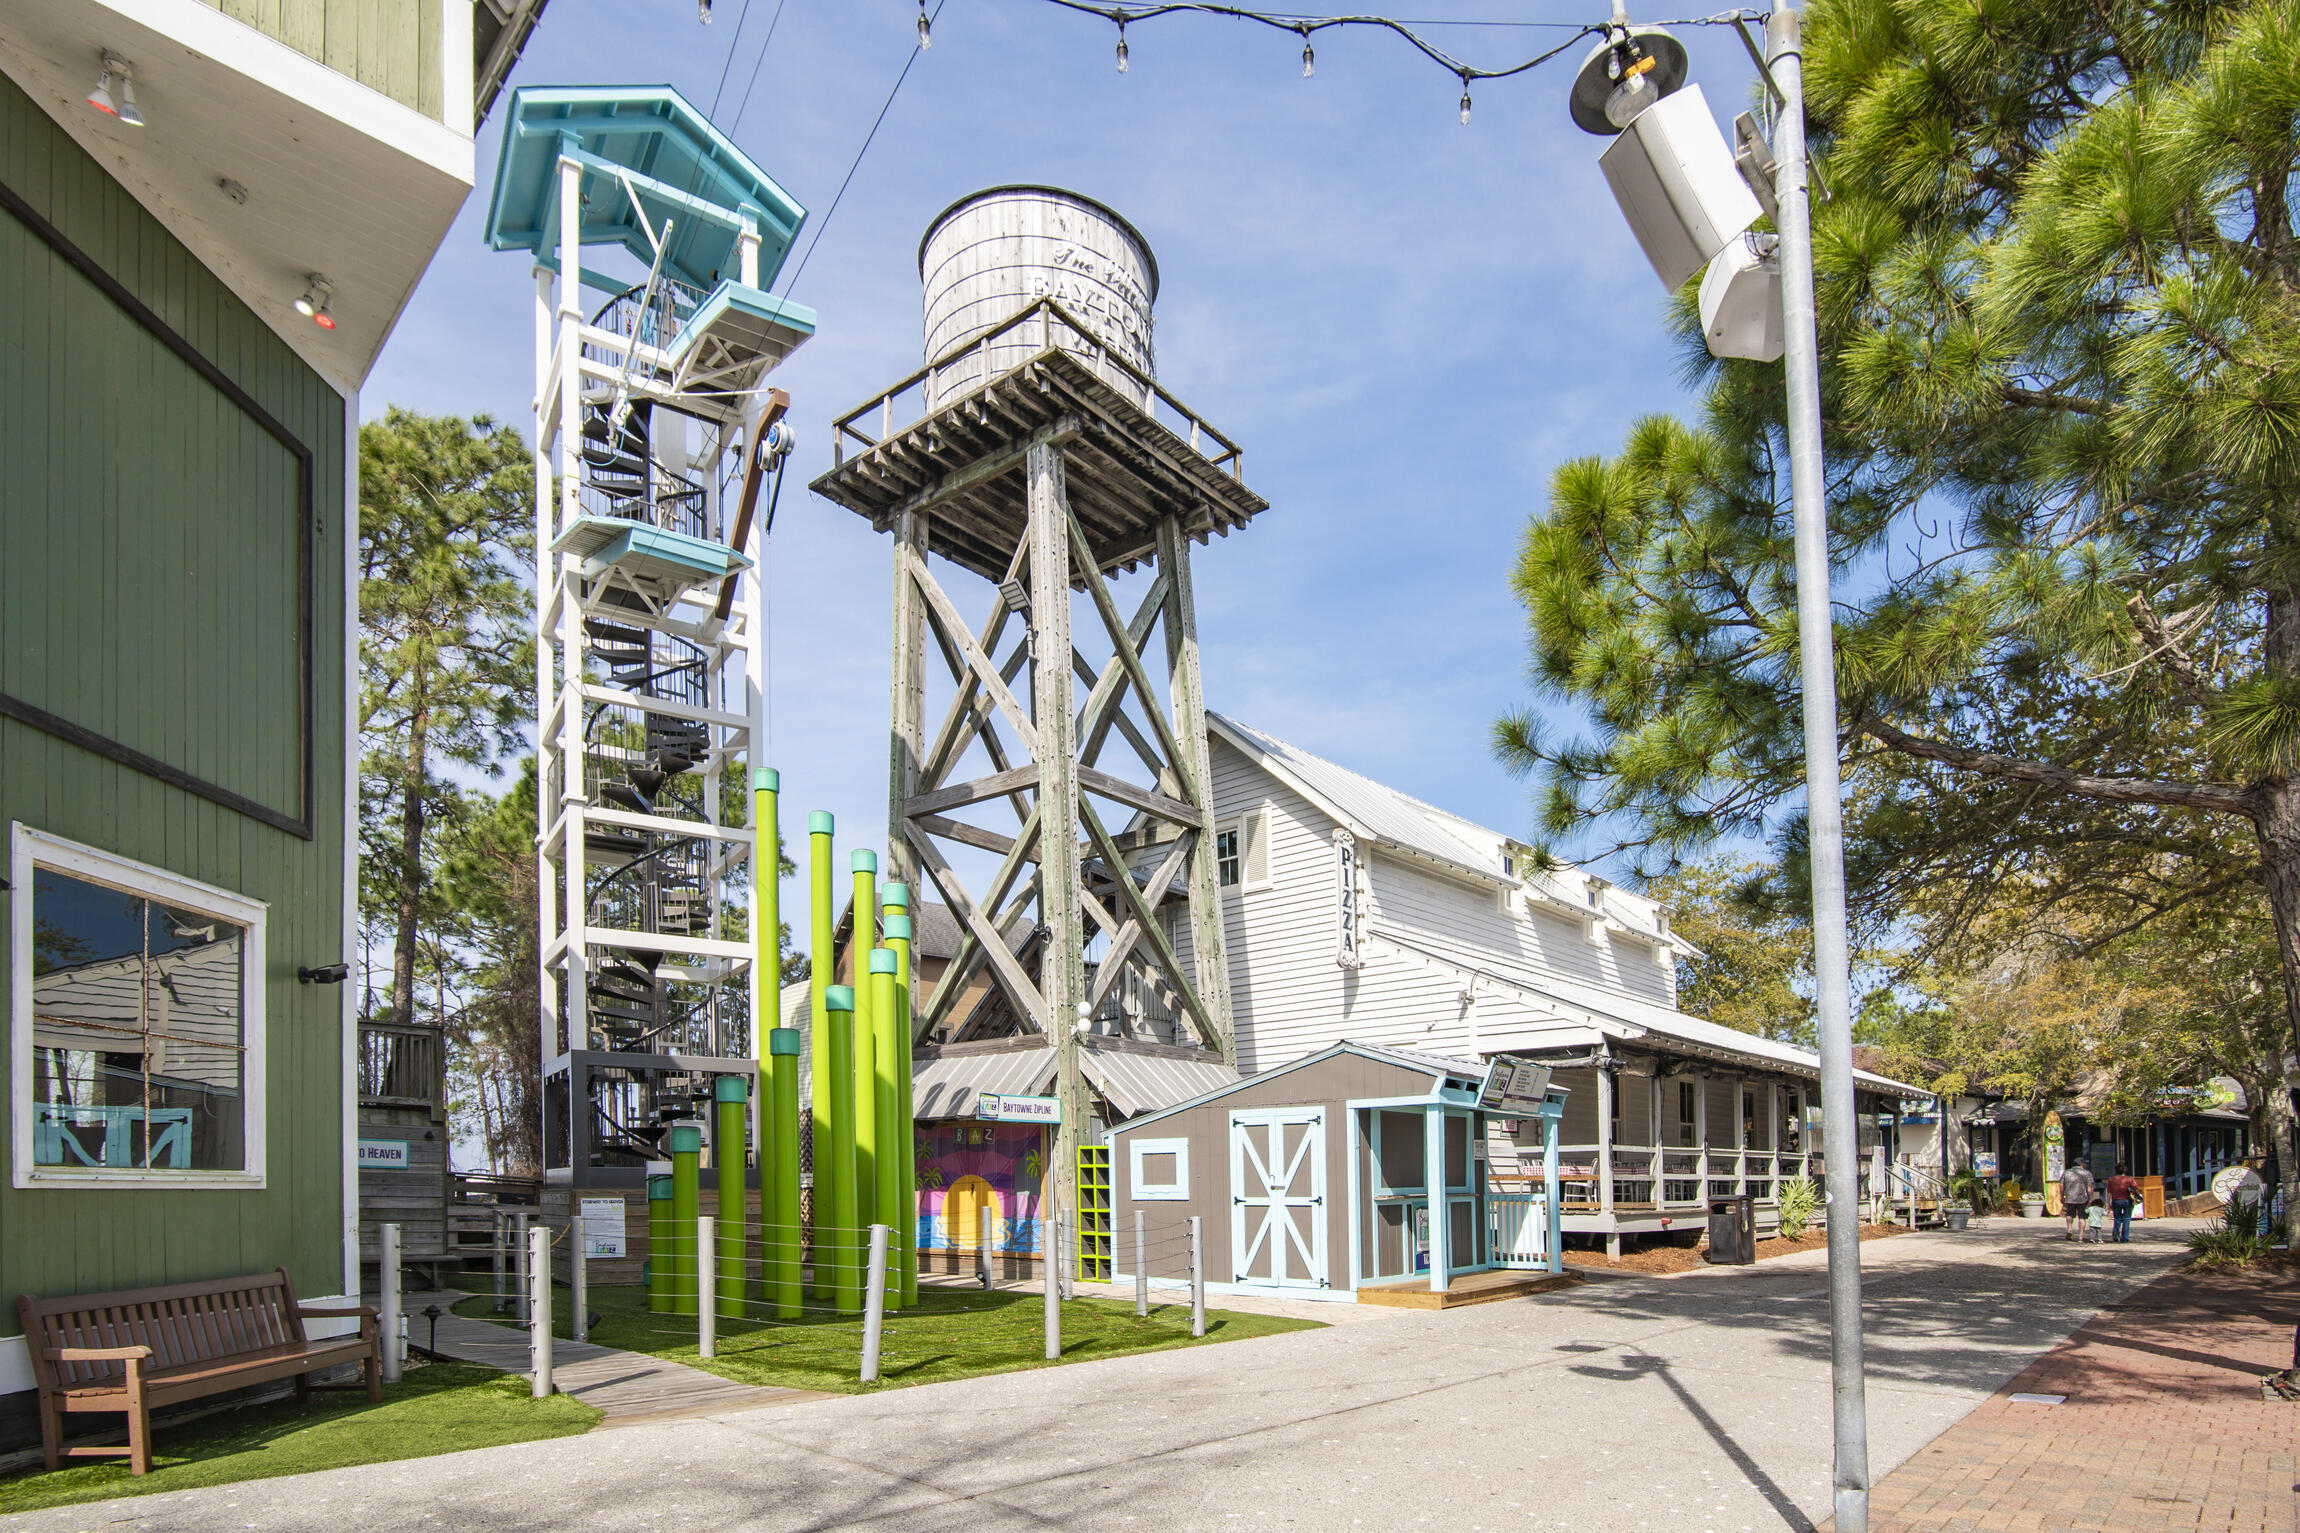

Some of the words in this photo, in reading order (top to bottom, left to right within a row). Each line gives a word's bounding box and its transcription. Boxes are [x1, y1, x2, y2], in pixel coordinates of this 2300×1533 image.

[1341, 846, 1353, 952] PIZZA
[1003, 1102, 1033, 1114] BAYTOWNE
[1034, 1103, 1052, 1115] ZIPLINE
[368, 1147, 402, 1159] HEAVEN
